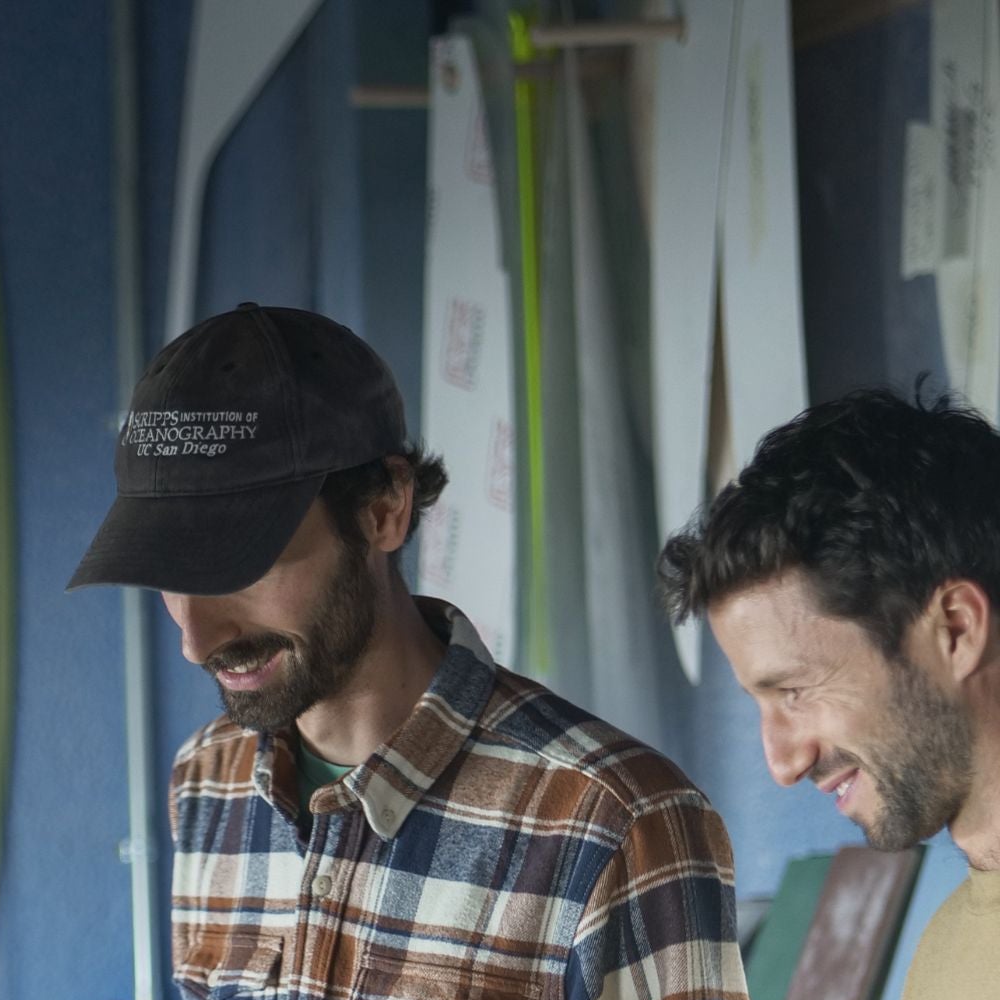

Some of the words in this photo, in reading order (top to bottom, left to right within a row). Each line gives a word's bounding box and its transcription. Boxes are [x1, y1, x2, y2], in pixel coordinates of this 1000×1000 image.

[180, 411, 242, 423] INSTITUTION
[245, 412, 259, 423] OF
[136, 443, 152, 456] UC
[153, 443, 178, 456] San
[181, 441, 227, 457] Diego
